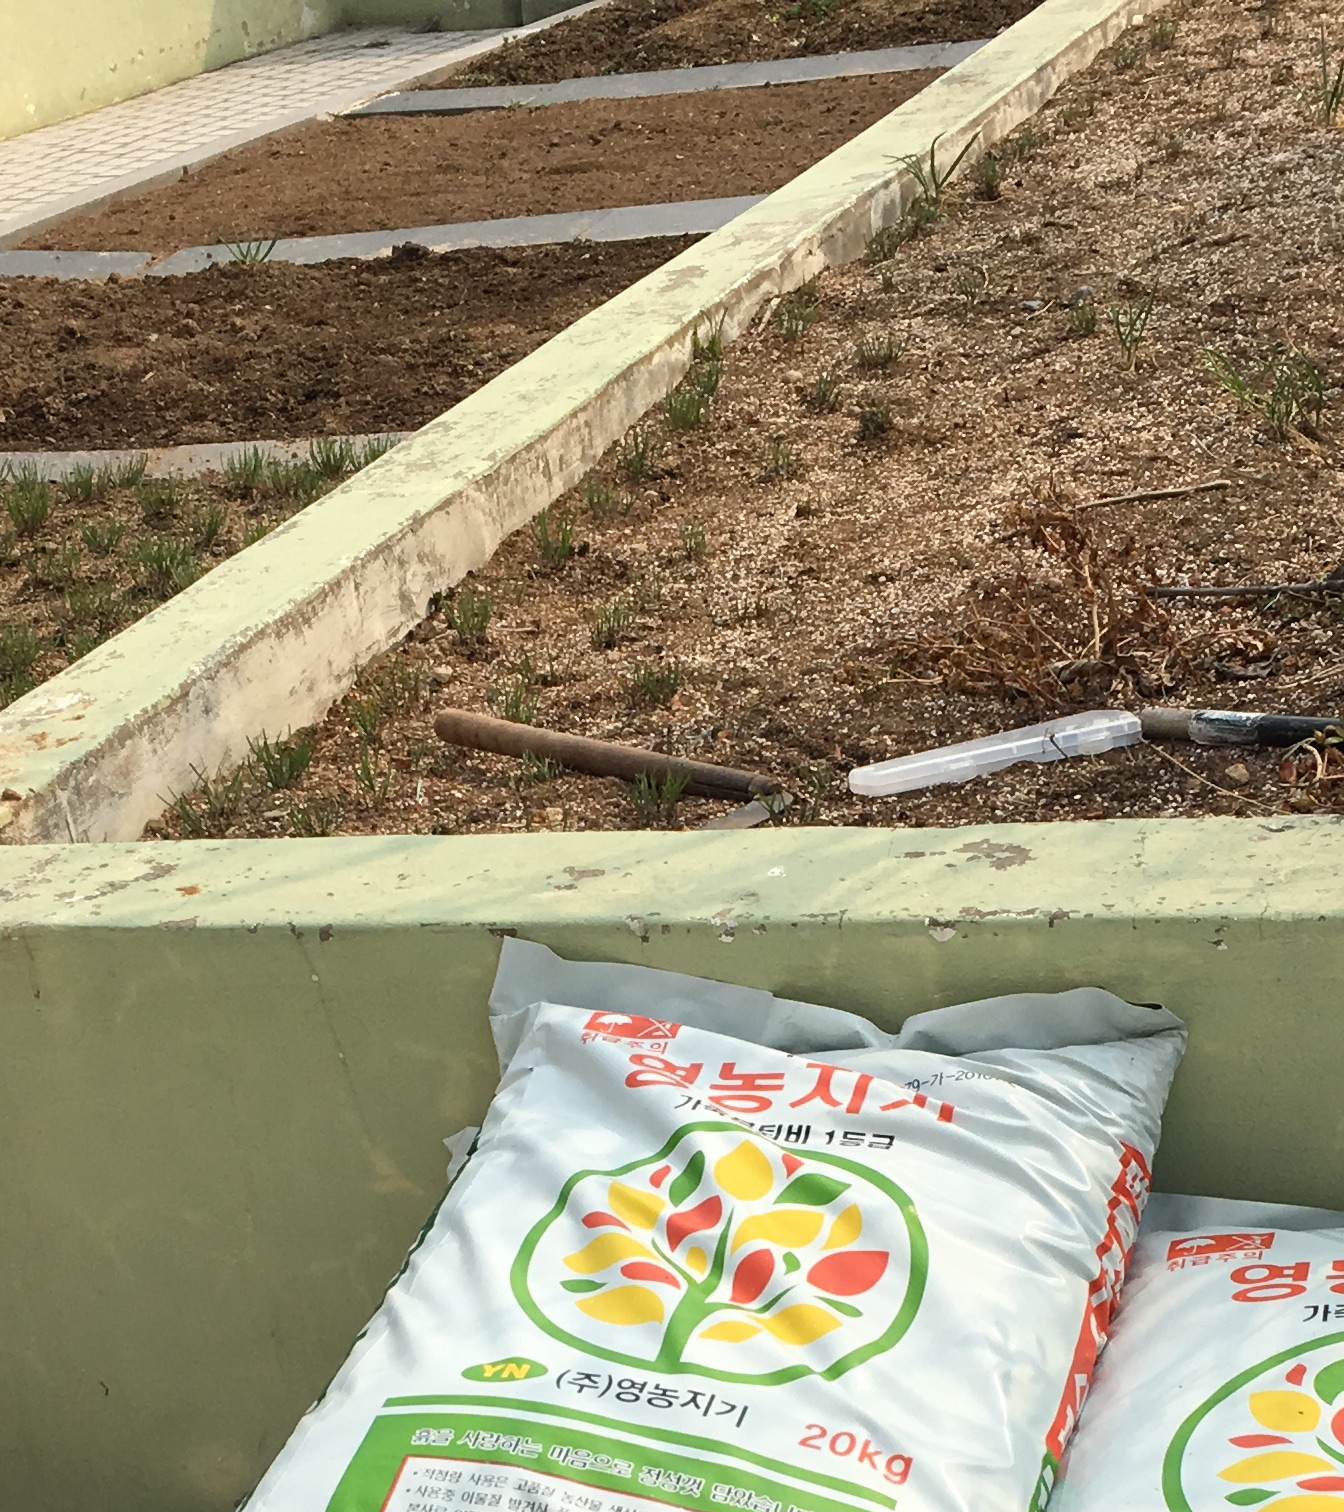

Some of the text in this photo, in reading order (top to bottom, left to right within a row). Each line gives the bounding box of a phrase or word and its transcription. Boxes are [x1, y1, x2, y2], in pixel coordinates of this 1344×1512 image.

[1166, 1249, 1265, 1272] 취급주의
[479, 1361, 531, 1381] YN
[556, 1369, 749, 1429] (주)영농지기
[411, 1427, 454, 1447] 흙을
[457, 1428, 544, 1458] 사랑하는
[549, 1444, 633, 1480] 마음으로
[639, 1464, 704, 1500] 정성껏
[798, 1422, 914, 1486] 20kg
[414, 1483, 454, 1503] 사용중
[461, 1489, 502, 1510] 이물질
[468, 1472, 509, 1492] 사용은
[515, 1477, 556, 1500] 고품질
[561, 1487, 602, 1510] 농산물
